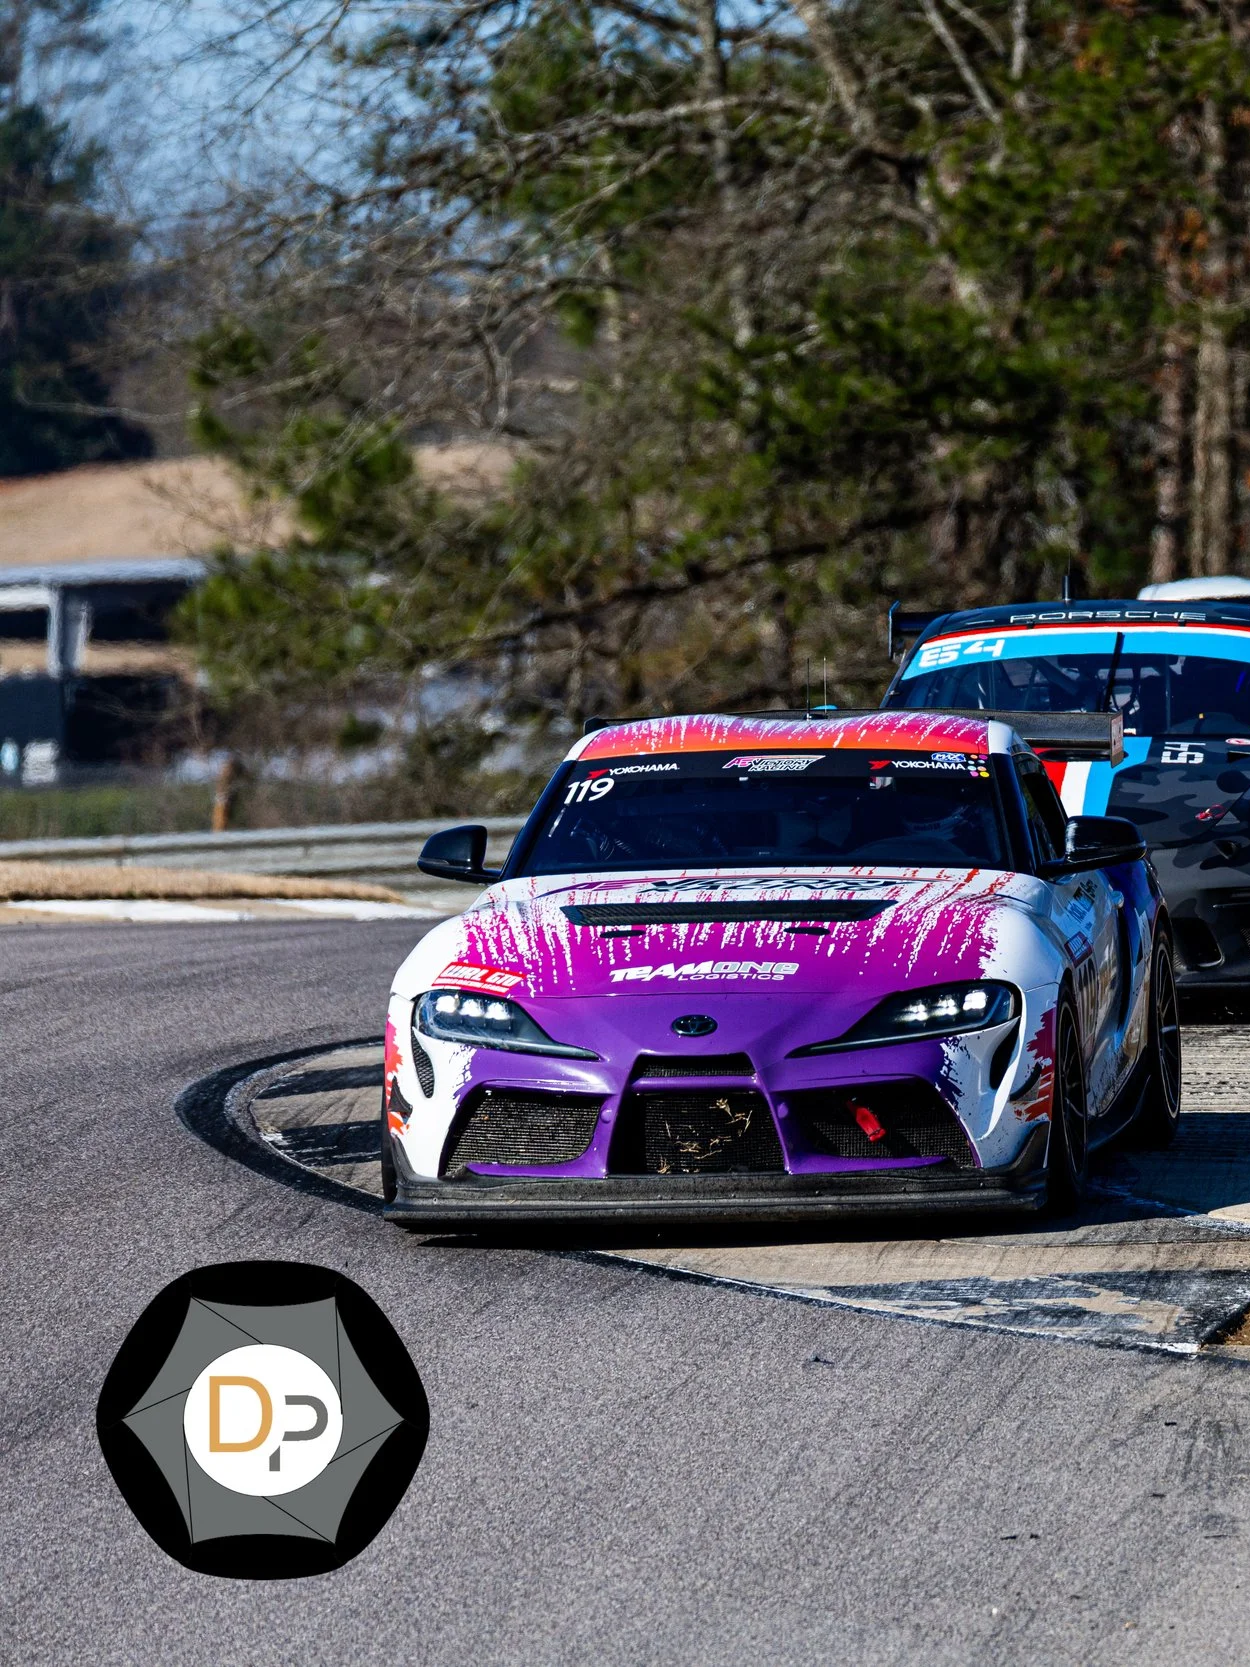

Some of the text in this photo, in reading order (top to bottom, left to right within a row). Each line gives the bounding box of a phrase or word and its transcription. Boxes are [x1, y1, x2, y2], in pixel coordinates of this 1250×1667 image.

[1009, 609, 1207, 624] PORSCHE
[1160, 741, 1207, 764] 54
[608, 762, 680, 777] YOKOHAMA
[891, 760, 966, 771] YOKOHAMA
[563, 777, 615, 805] 119
[439, 964, 491, 981] WRL
[678, 973, 785, 982] LOGISTICS
